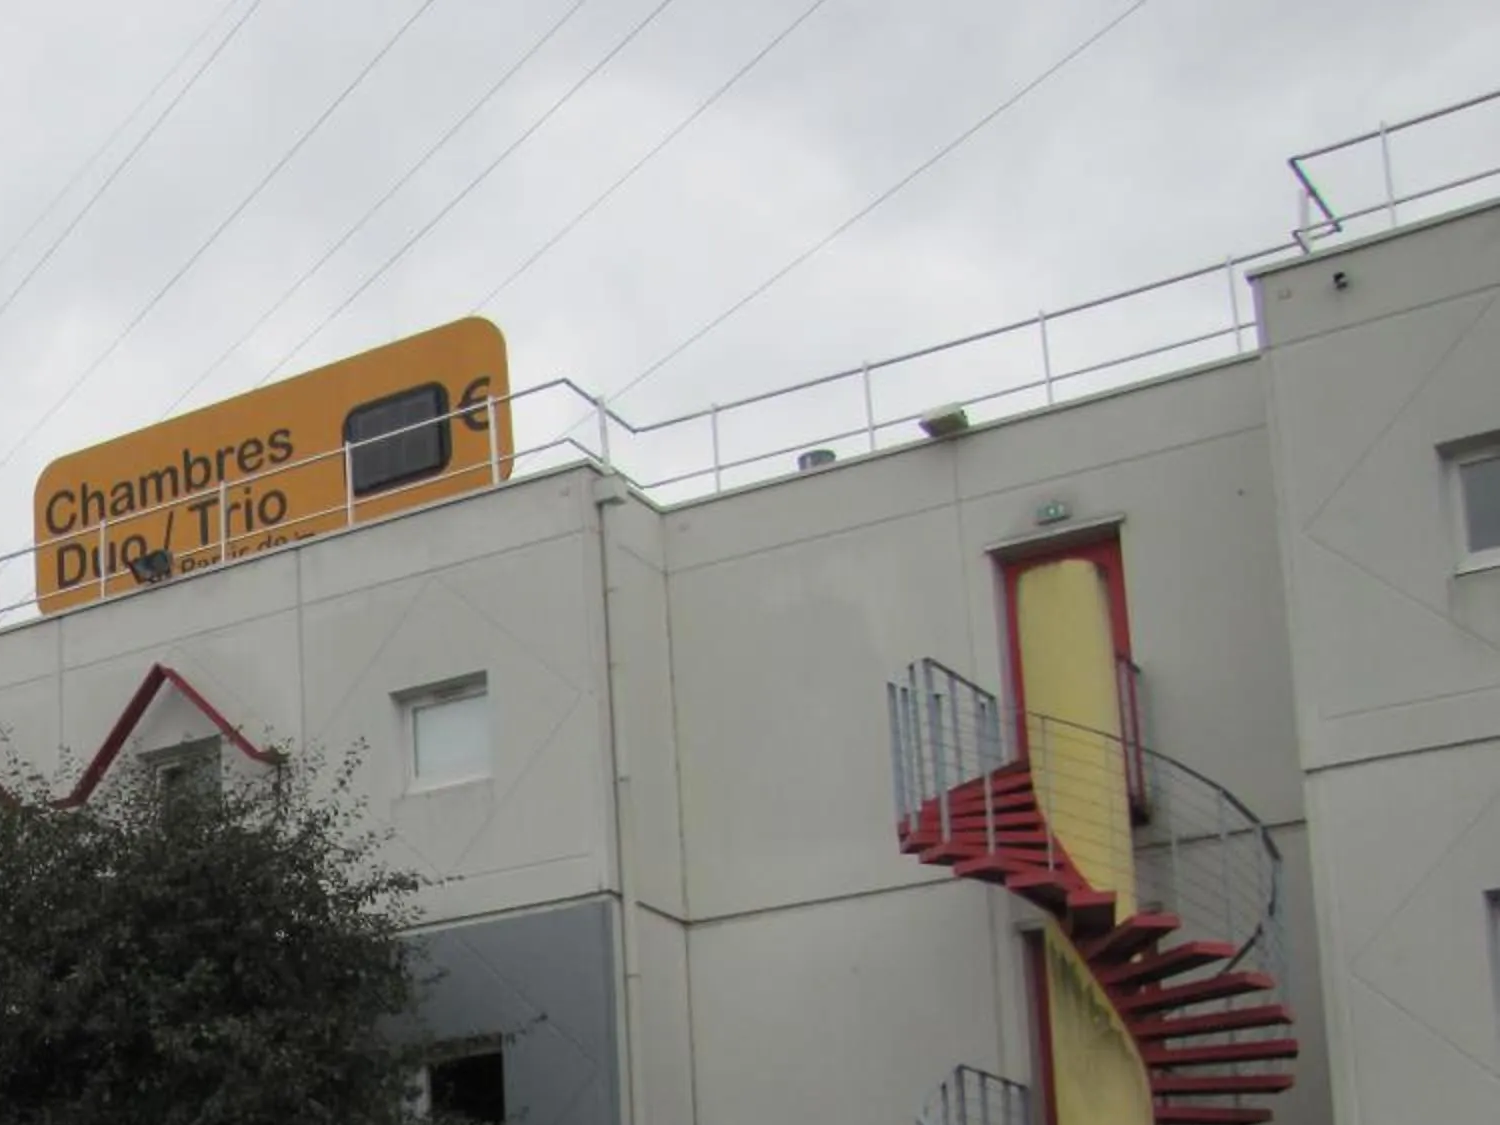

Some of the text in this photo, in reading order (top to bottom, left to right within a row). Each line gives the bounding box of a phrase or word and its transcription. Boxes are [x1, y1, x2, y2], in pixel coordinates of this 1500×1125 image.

[46, 428, 294, 534] Chambres
[57, 534, 147, 588] Duo
[188, 487, 287, 546] Trio
